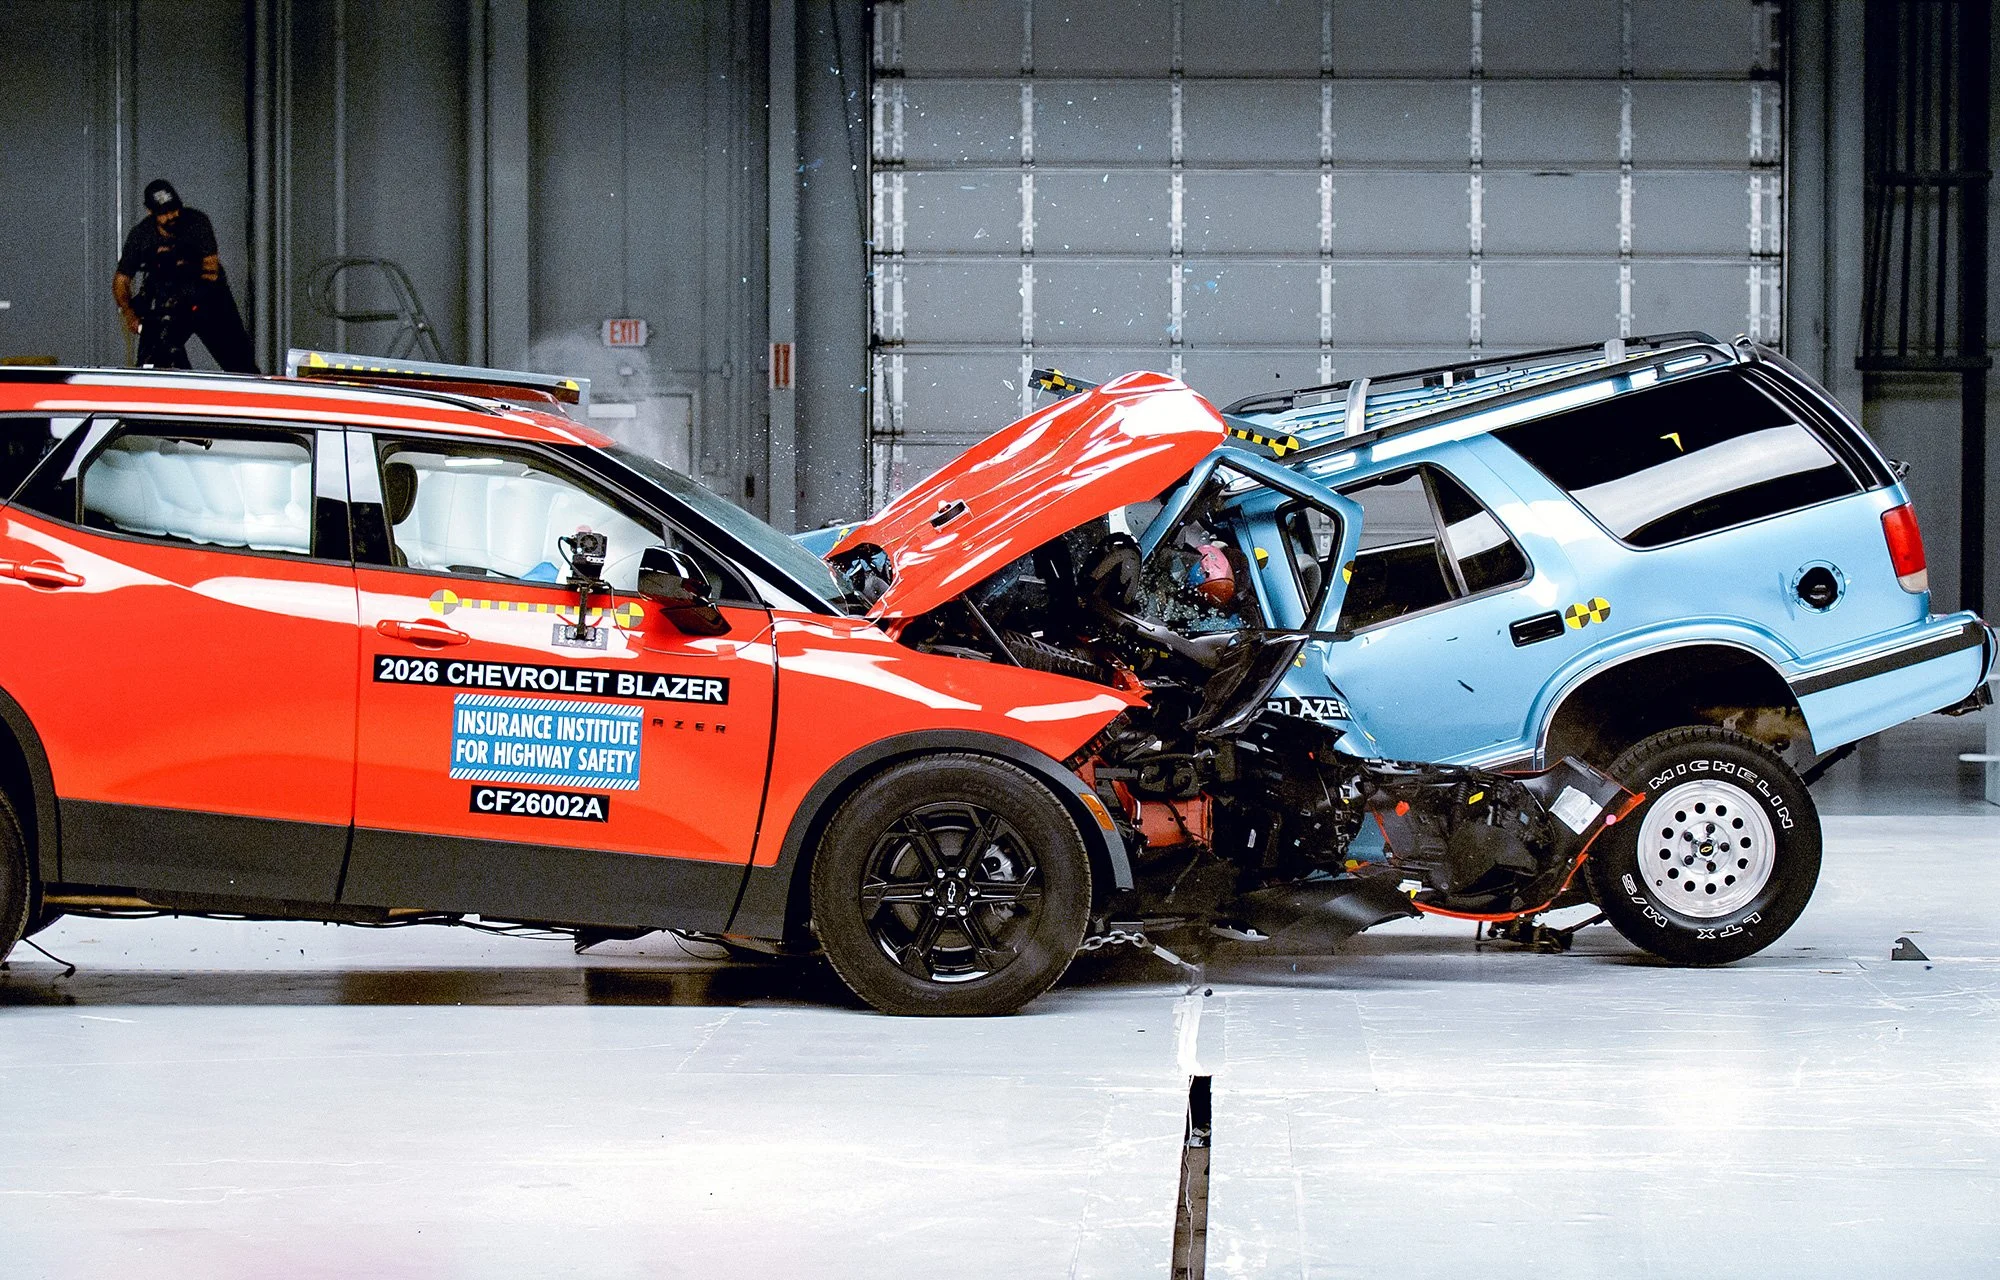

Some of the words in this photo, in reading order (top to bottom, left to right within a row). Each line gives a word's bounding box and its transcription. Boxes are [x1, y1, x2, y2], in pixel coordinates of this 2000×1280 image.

[610, 320, 639, 344] EXIT
[379, 658, 438, 683] 2026
[446, 662, 610, 693] CHEVROLET
[617, 673, 724, 702] BLAZER
[457, 709, 552, 739] INSURANCE
[557, 716, 638, 745] INSTITUTE
[653, 717, 727, 734] AZER
[455, 740, 488, 764] FOR
[494, 741, 573, 769] HIGHWAY
[578, 746, 637, 774] SAFETY
[475, 789, 604, 819] CF26002A
[1648, 760, 1794, 829] MICHELIN
[1697, 912, 1761, 940] LTX
